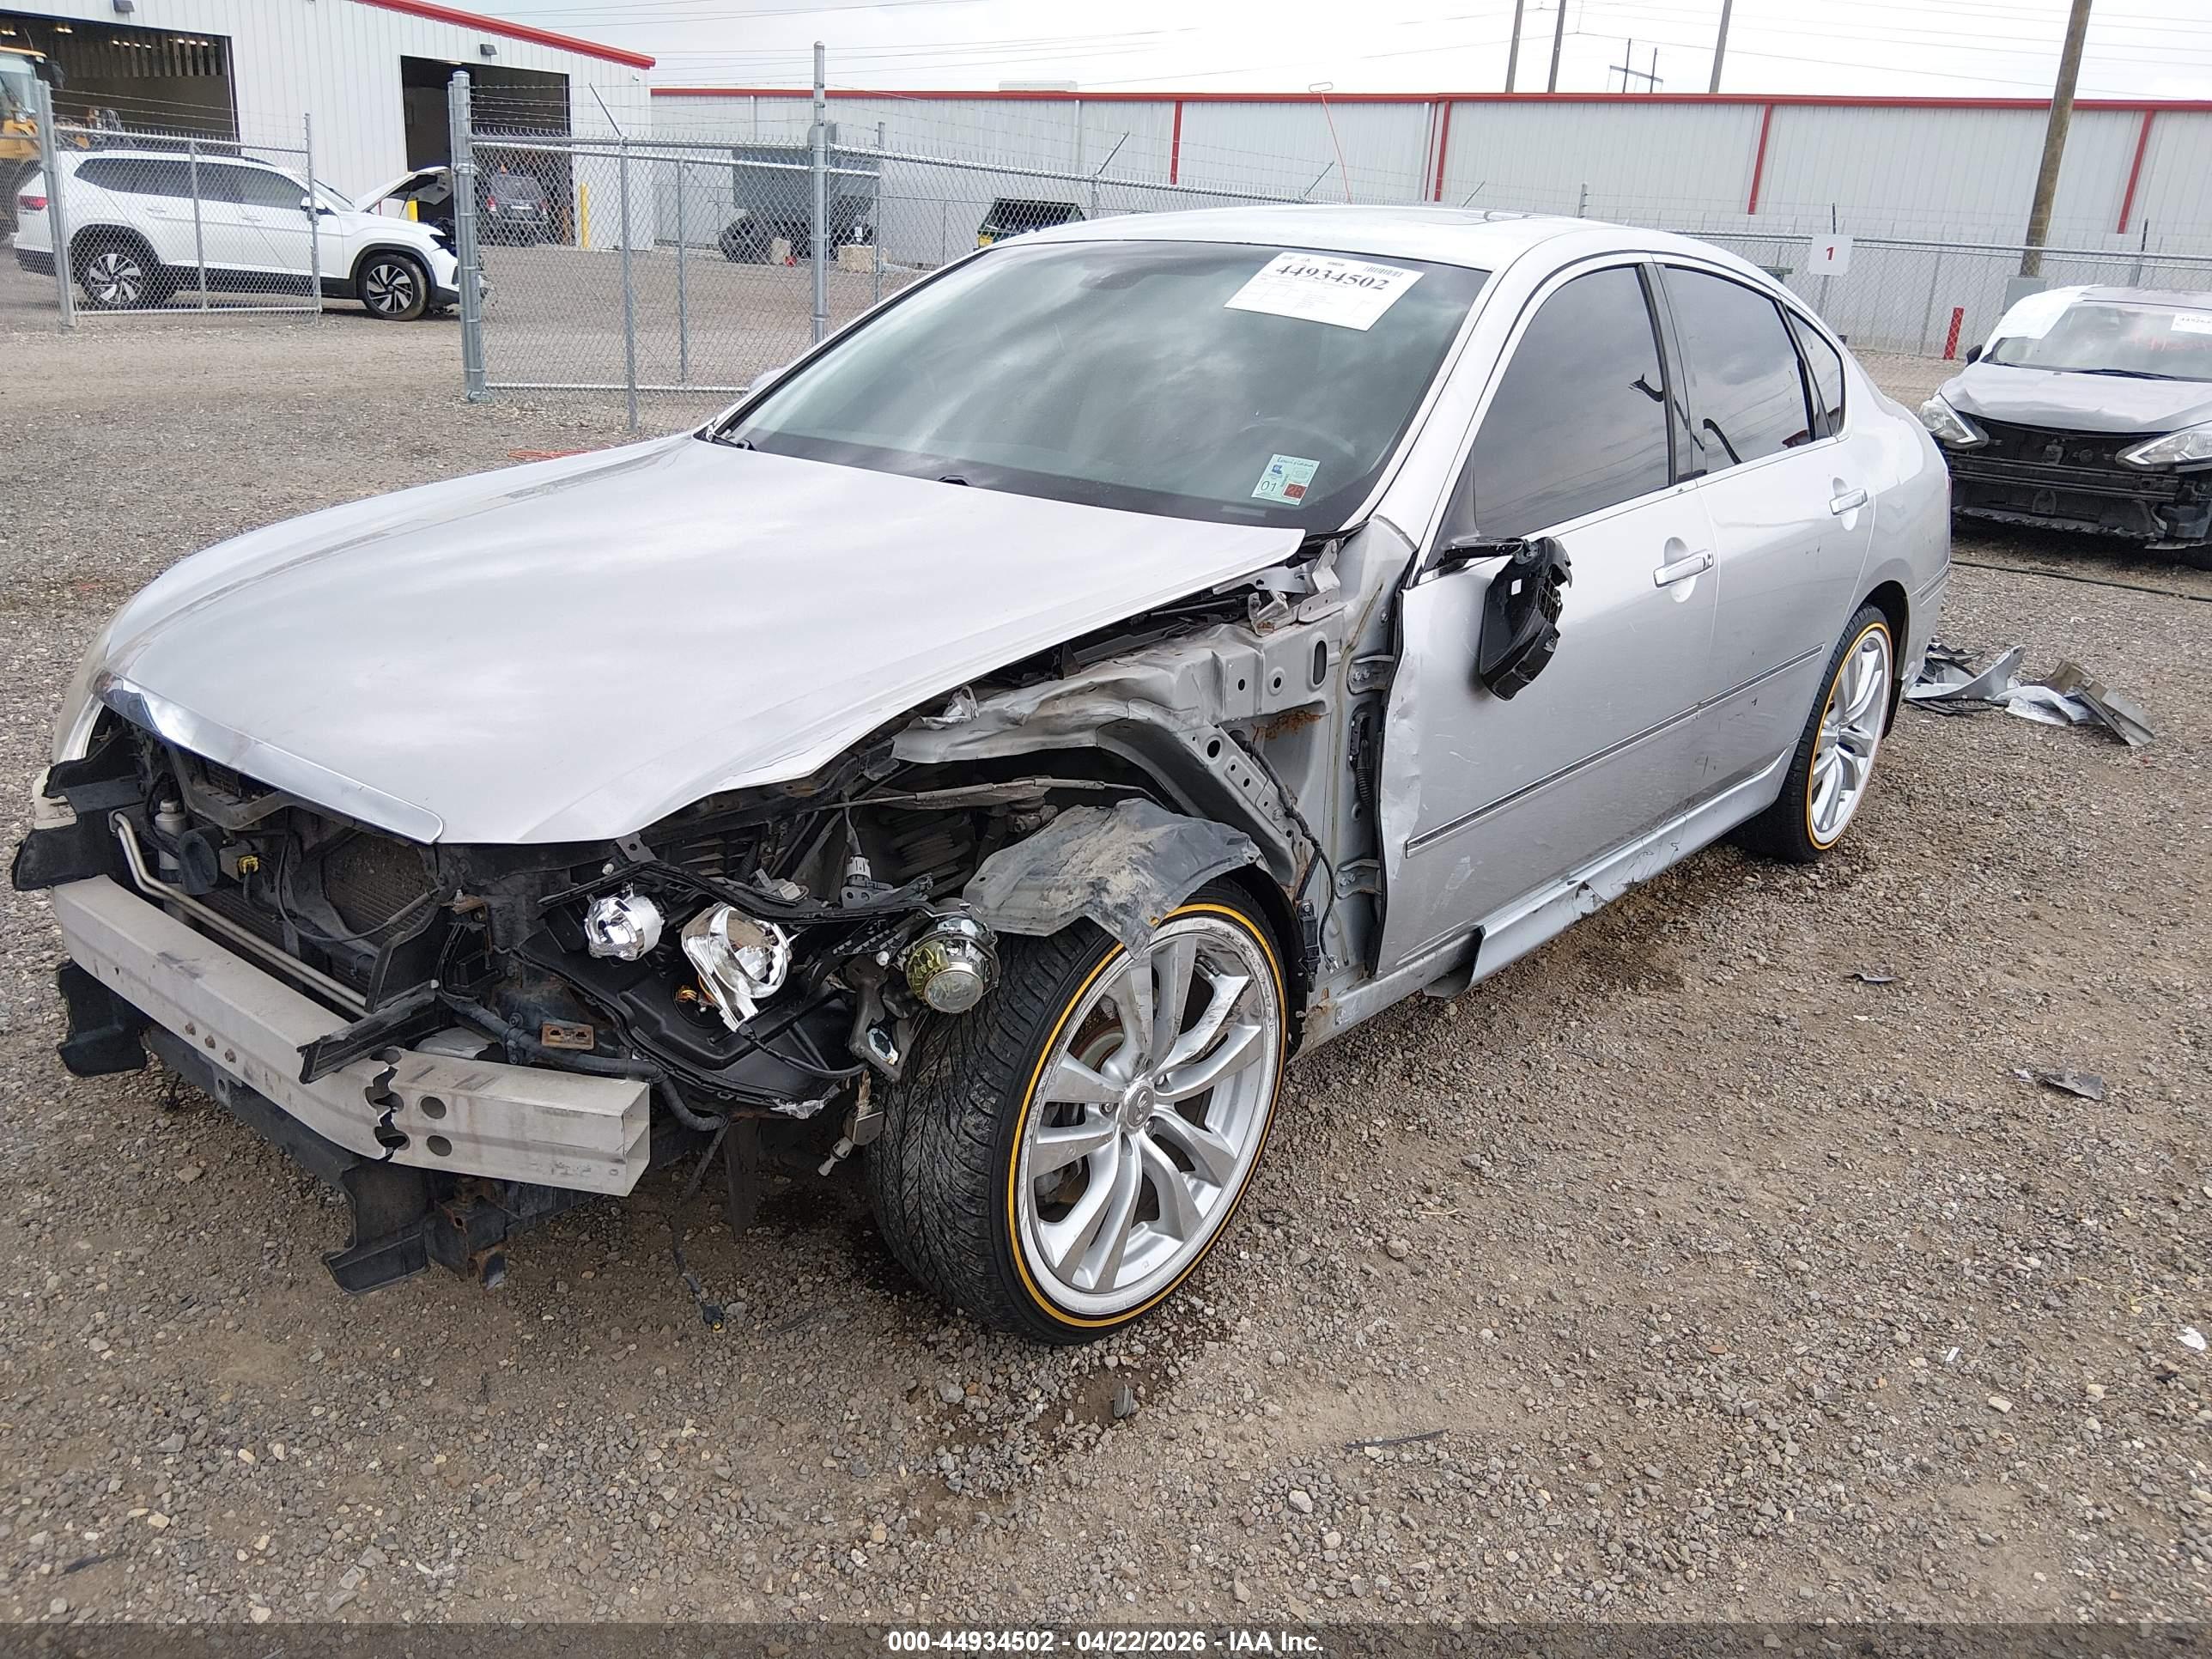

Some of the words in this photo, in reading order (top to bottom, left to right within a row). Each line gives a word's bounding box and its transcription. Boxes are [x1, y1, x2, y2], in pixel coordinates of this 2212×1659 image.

[1826, 246, 1834, 261] 1
[1276, 264, 1389, 290] 44934502
[1261, 480, 1277, 492] 01
